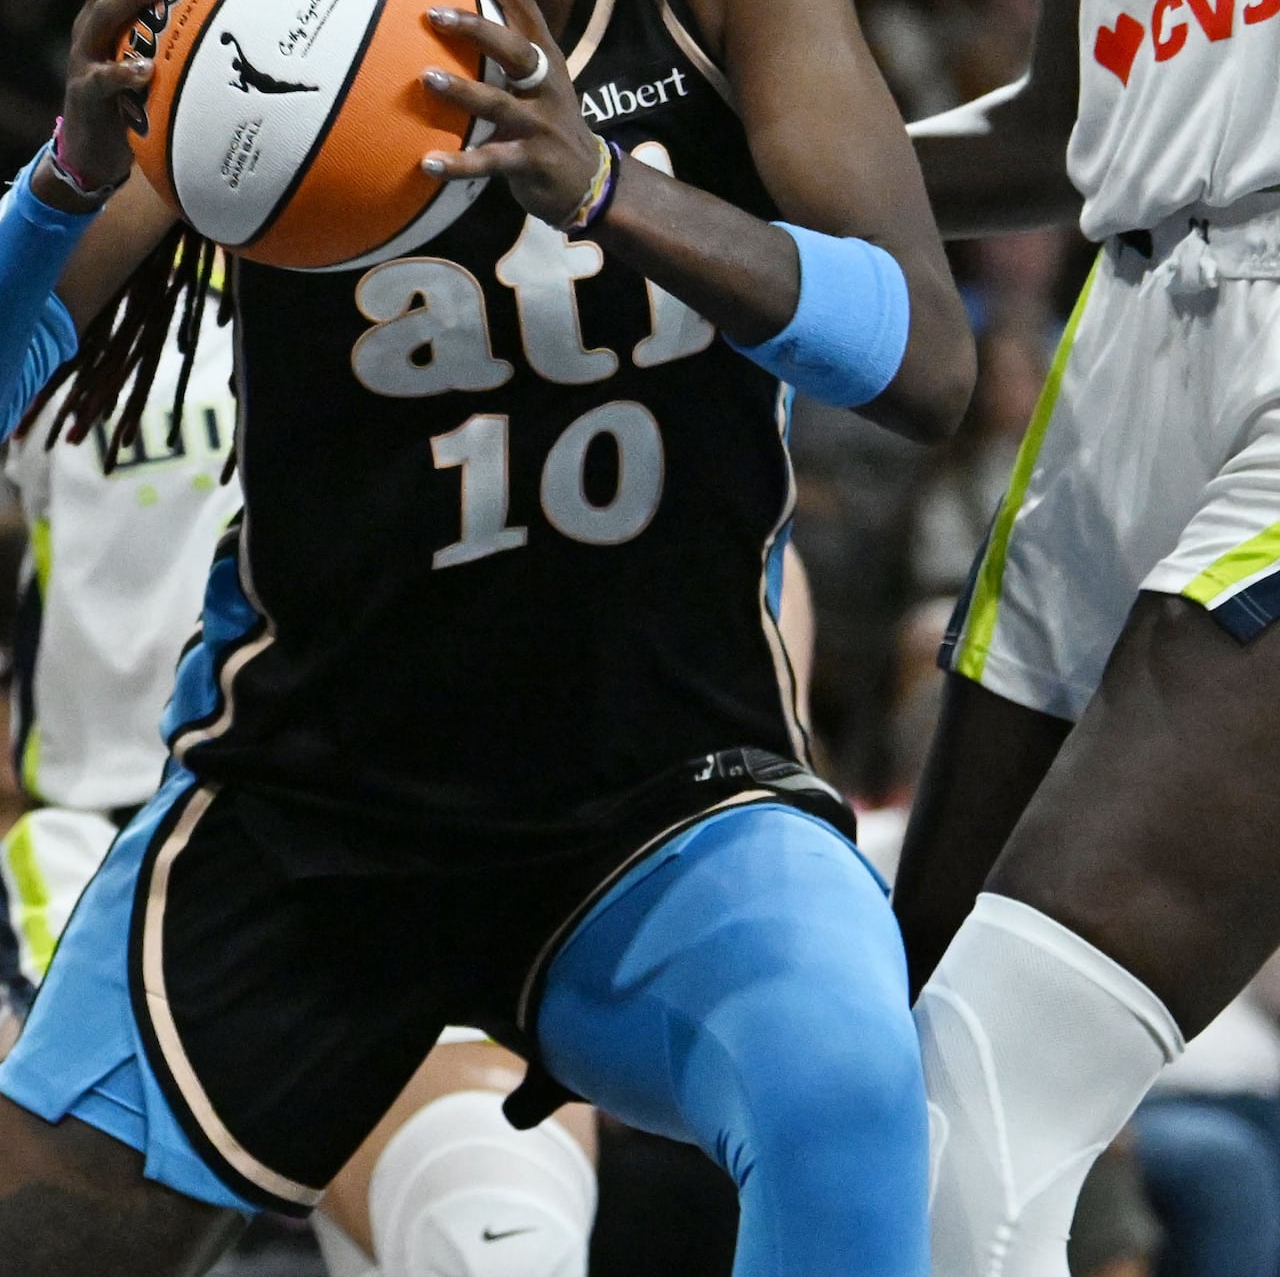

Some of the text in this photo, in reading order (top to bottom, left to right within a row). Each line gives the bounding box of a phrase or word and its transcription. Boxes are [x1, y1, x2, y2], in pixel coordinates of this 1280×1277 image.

[581, 67, 689, 123] Albert
[221, 122, 248, 175] OFFICIAL
[229, 153, 248, 188] GAME
[242, 119, 263, 153] BALL
[429, 400, 665, 571] 10
